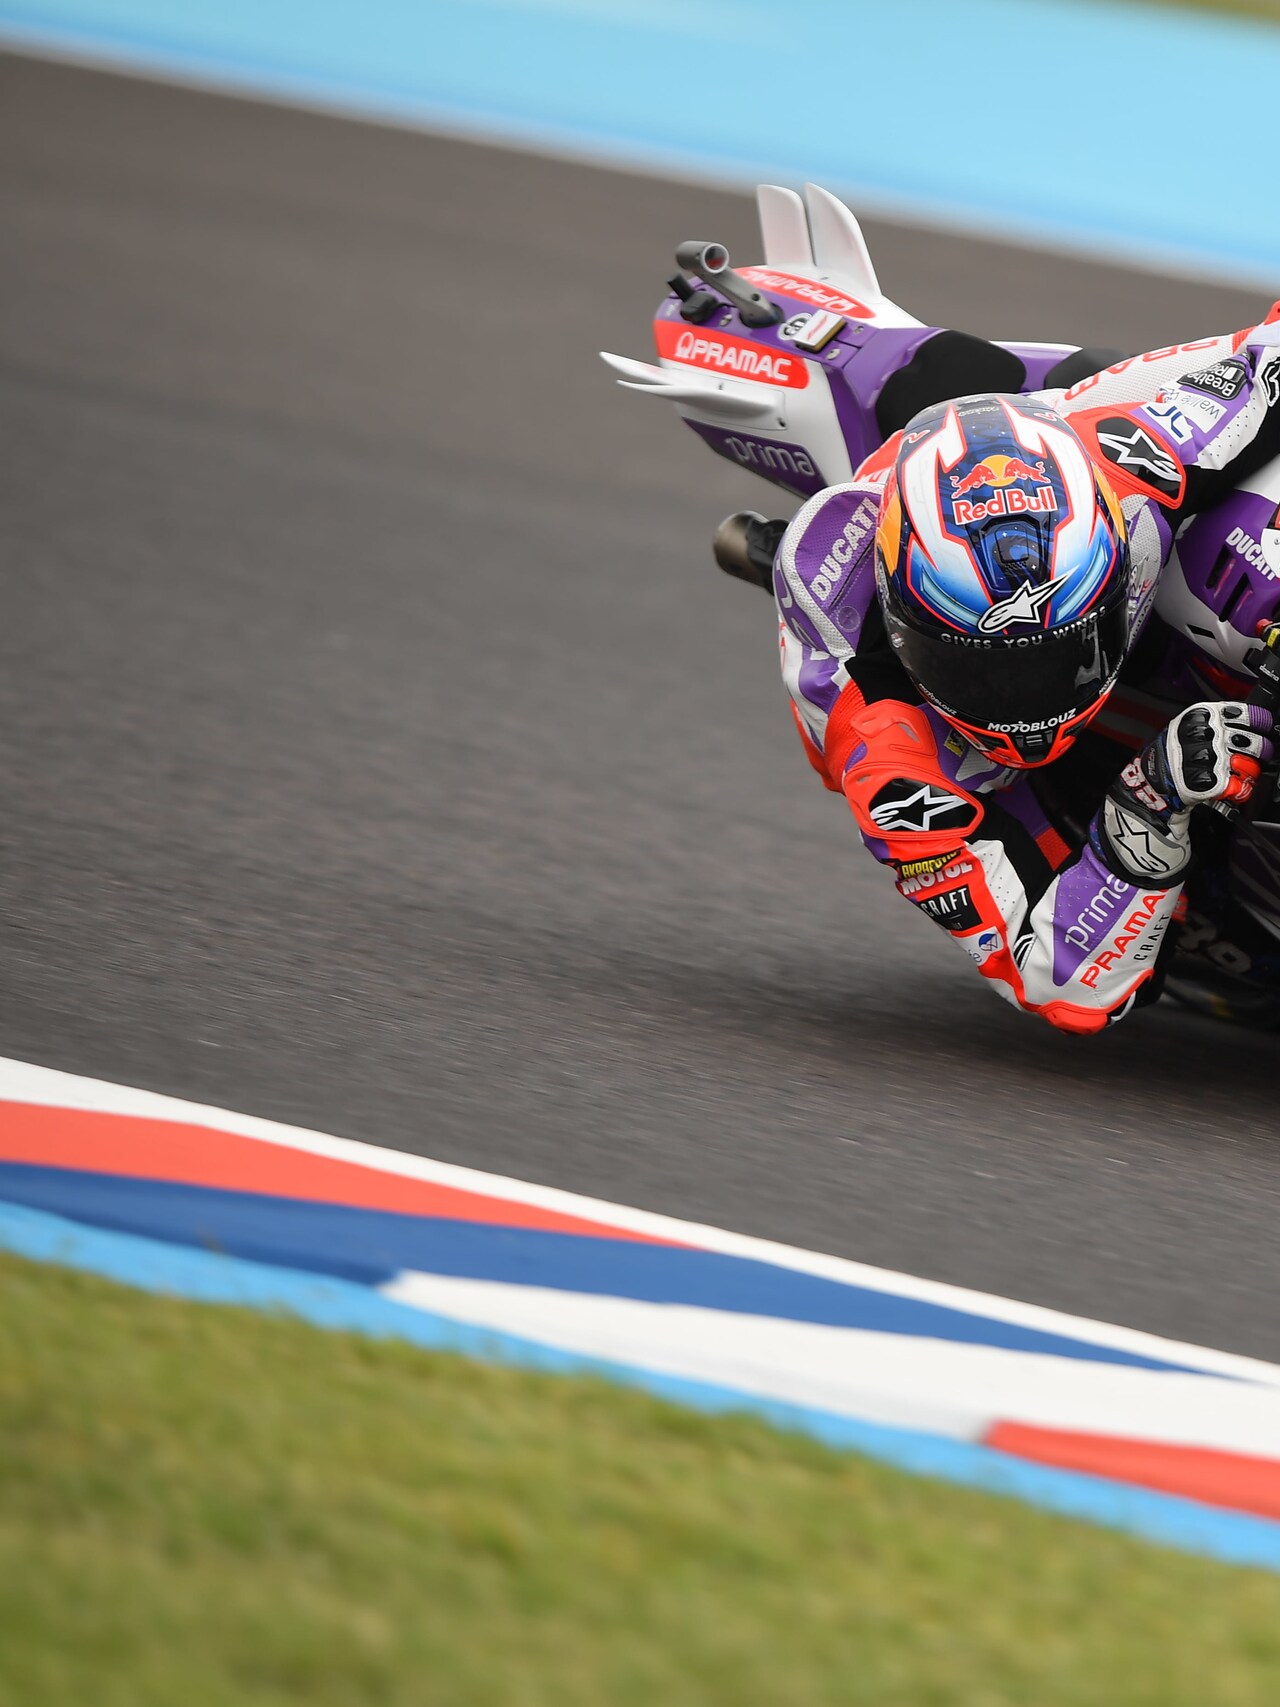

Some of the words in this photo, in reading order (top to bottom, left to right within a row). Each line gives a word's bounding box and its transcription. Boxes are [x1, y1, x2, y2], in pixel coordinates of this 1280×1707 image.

[689, 339, 792, 381] PRAMAC
[724, 436, 815, 476] prima
[953, 491, 1004, 524] Red
[1007, 487, 1057, 513] Bull
[809, 497, 880, 601] DUCATI
[1225, 527, 1276, 581] DUCATI
[940, 633, 992, 649] GIVES
[1003, 635, 1043, 648] YOU
[1053, 606, 1107, 640] WINGS
[987, 708, 1077, 733] MOTOBLOUZ
[901, 861, 972, 895] MOTUL
[920, 889, 968, 917] CRAFT
[1065, 873, 1130, 951] prima
[1133, 914, 1169, 961] CRAFT
